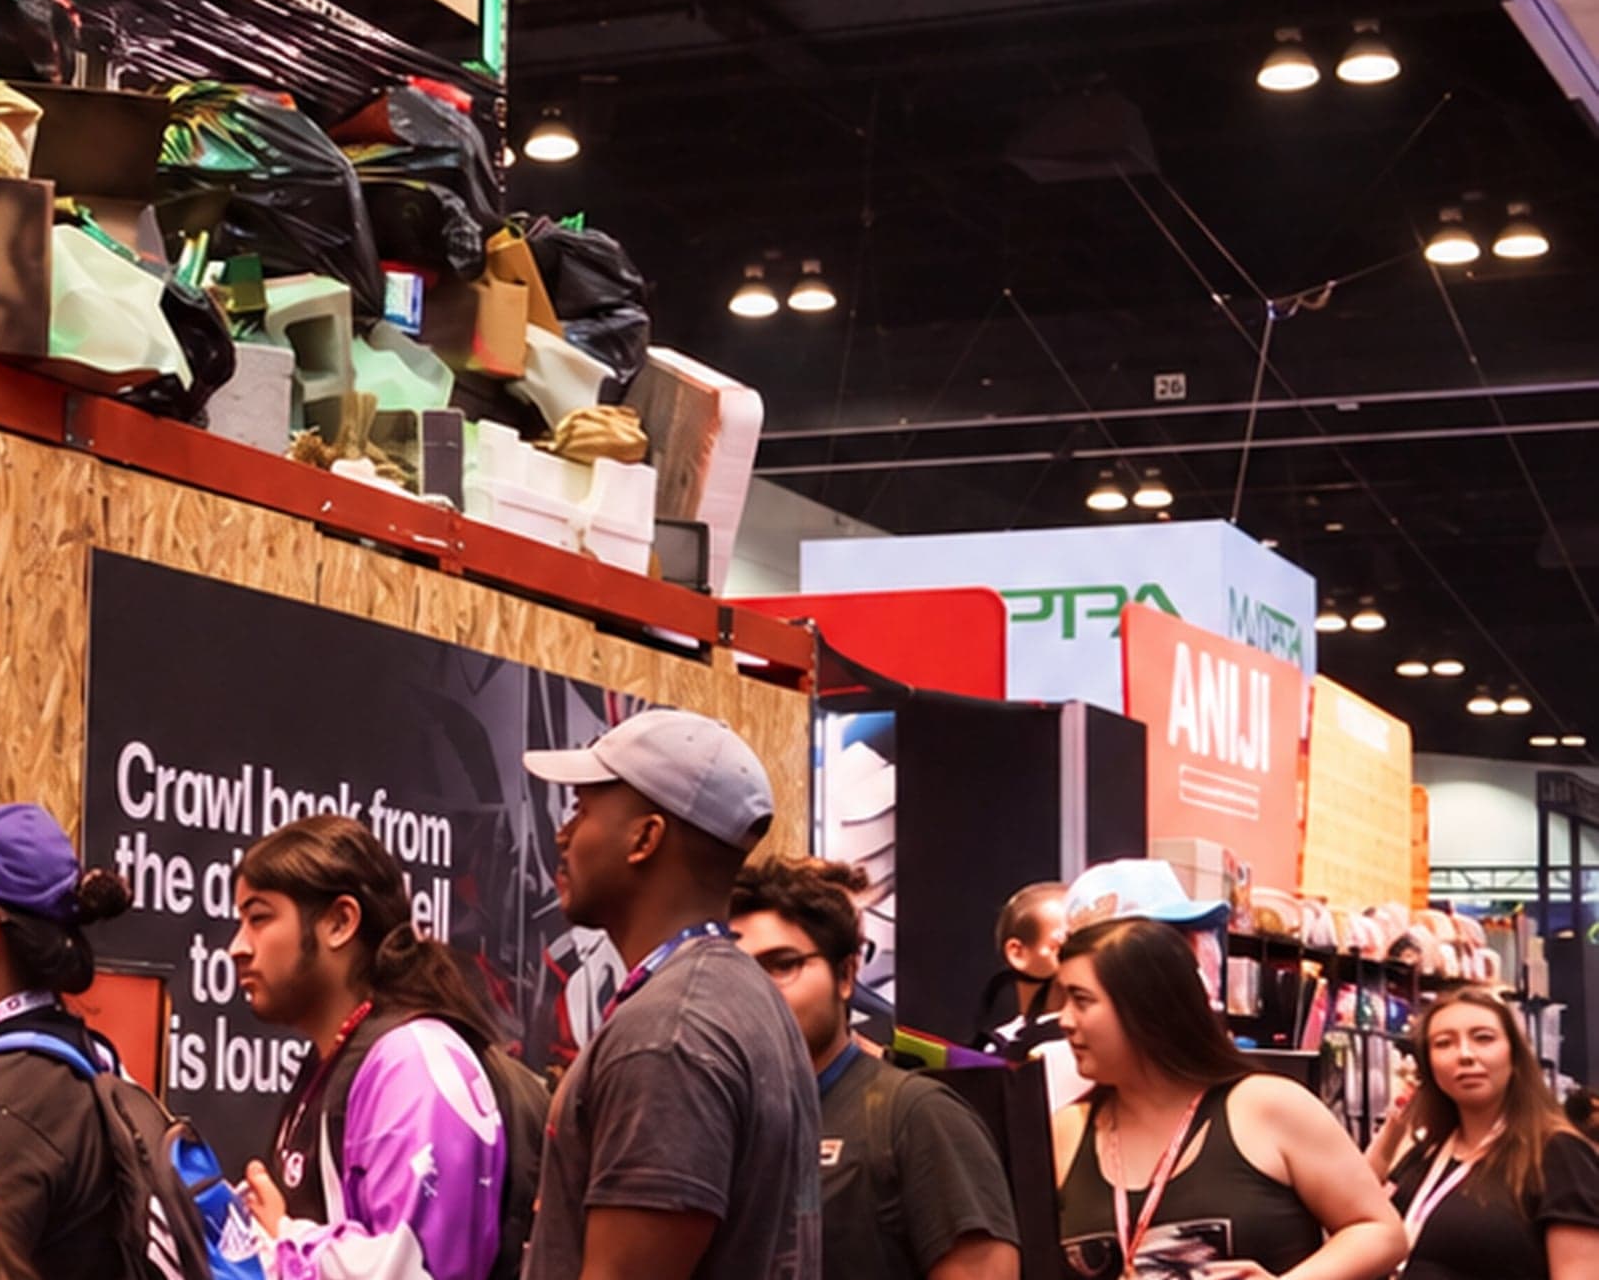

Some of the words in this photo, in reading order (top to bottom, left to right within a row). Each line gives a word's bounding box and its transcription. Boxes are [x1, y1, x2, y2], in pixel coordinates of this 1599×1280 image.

[116, 740, 253, 836] Crawl
[368, 788, 451, 868] from
[115, 831, 194, 914] the
[190, 933, 236, 1005] to
[215, 1016, 312, 1095] lous
